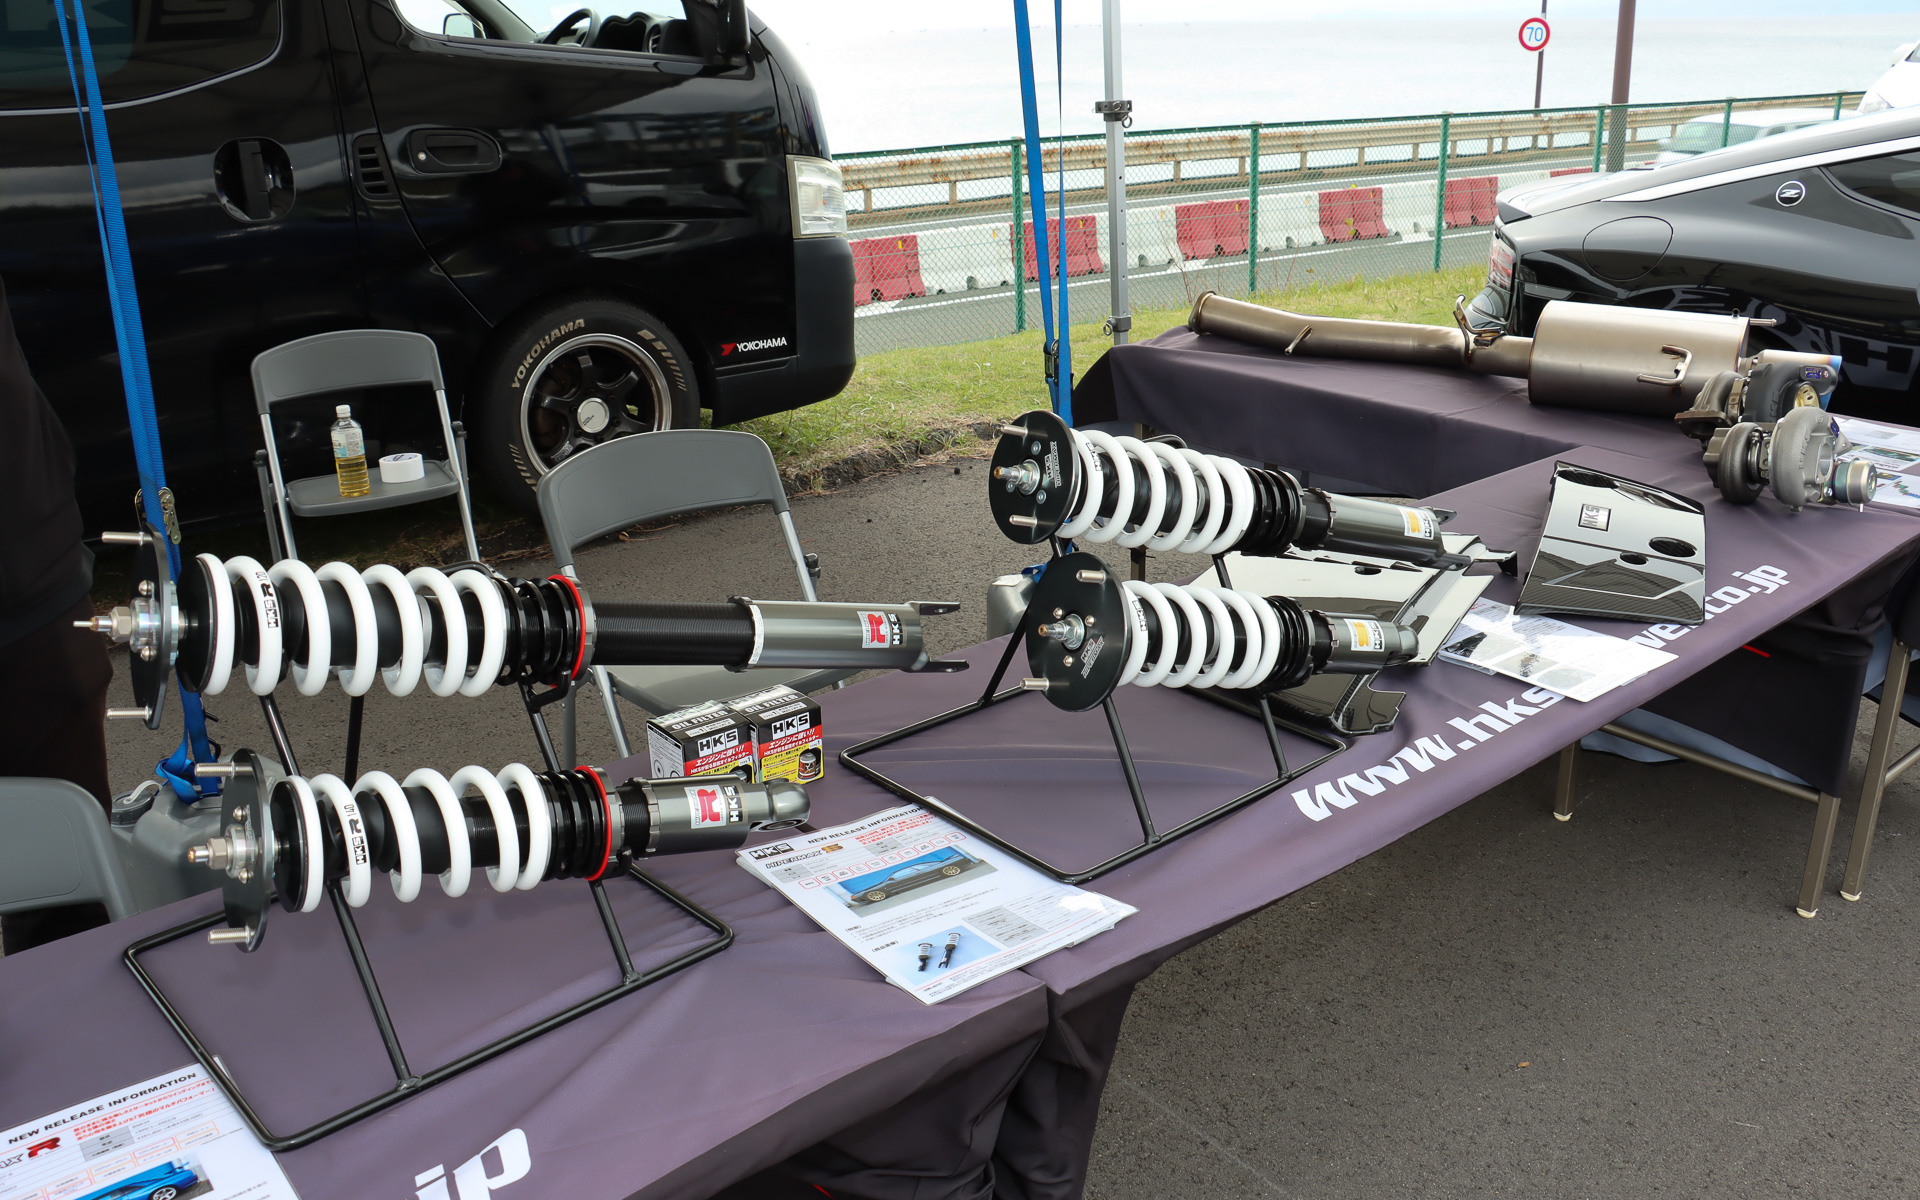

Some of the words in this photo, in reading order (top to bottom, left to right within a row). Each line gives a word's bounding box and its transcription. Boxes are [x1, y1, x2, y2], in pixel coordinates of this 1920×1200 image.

[1526, 26, 1544, 42] 70
[511, 318, 585, 390] YOKOHAMA
[736, 336, 788, 353] YOKOHAMA
[1582, 505, 1600, 527] HKS
[266, 599, 280, 629] HKS
[888, 613, 902, 646] HKS
[1371, 621, 1383, 651] HKS
[744, 703, 764, 713] OIL
[764, 694, 798, 709] FILTER
[671, 720, 691, 731] OIL
[692, 710, 728, 726] FILTER
[773, 713, 810, 737] HKS
[699, 729, 738, 754] HKS
[723, 786, 741, 823] HKS
[807, 836, 828, 845] NEW
[829, 824, 868, 839] RELEASE
[868, 807, 924, 828] INFORMATION
[354, 835, 370, 866] HKS
[748, 843, 795, 861] HKS
[765, 849, 822, 870] HIPERMAX
[8, 1131, 40, 1145] NEW
[44, 1105, 104, 1131] RELEASE
[108, 1072, 197, 1107] INFORMATION
